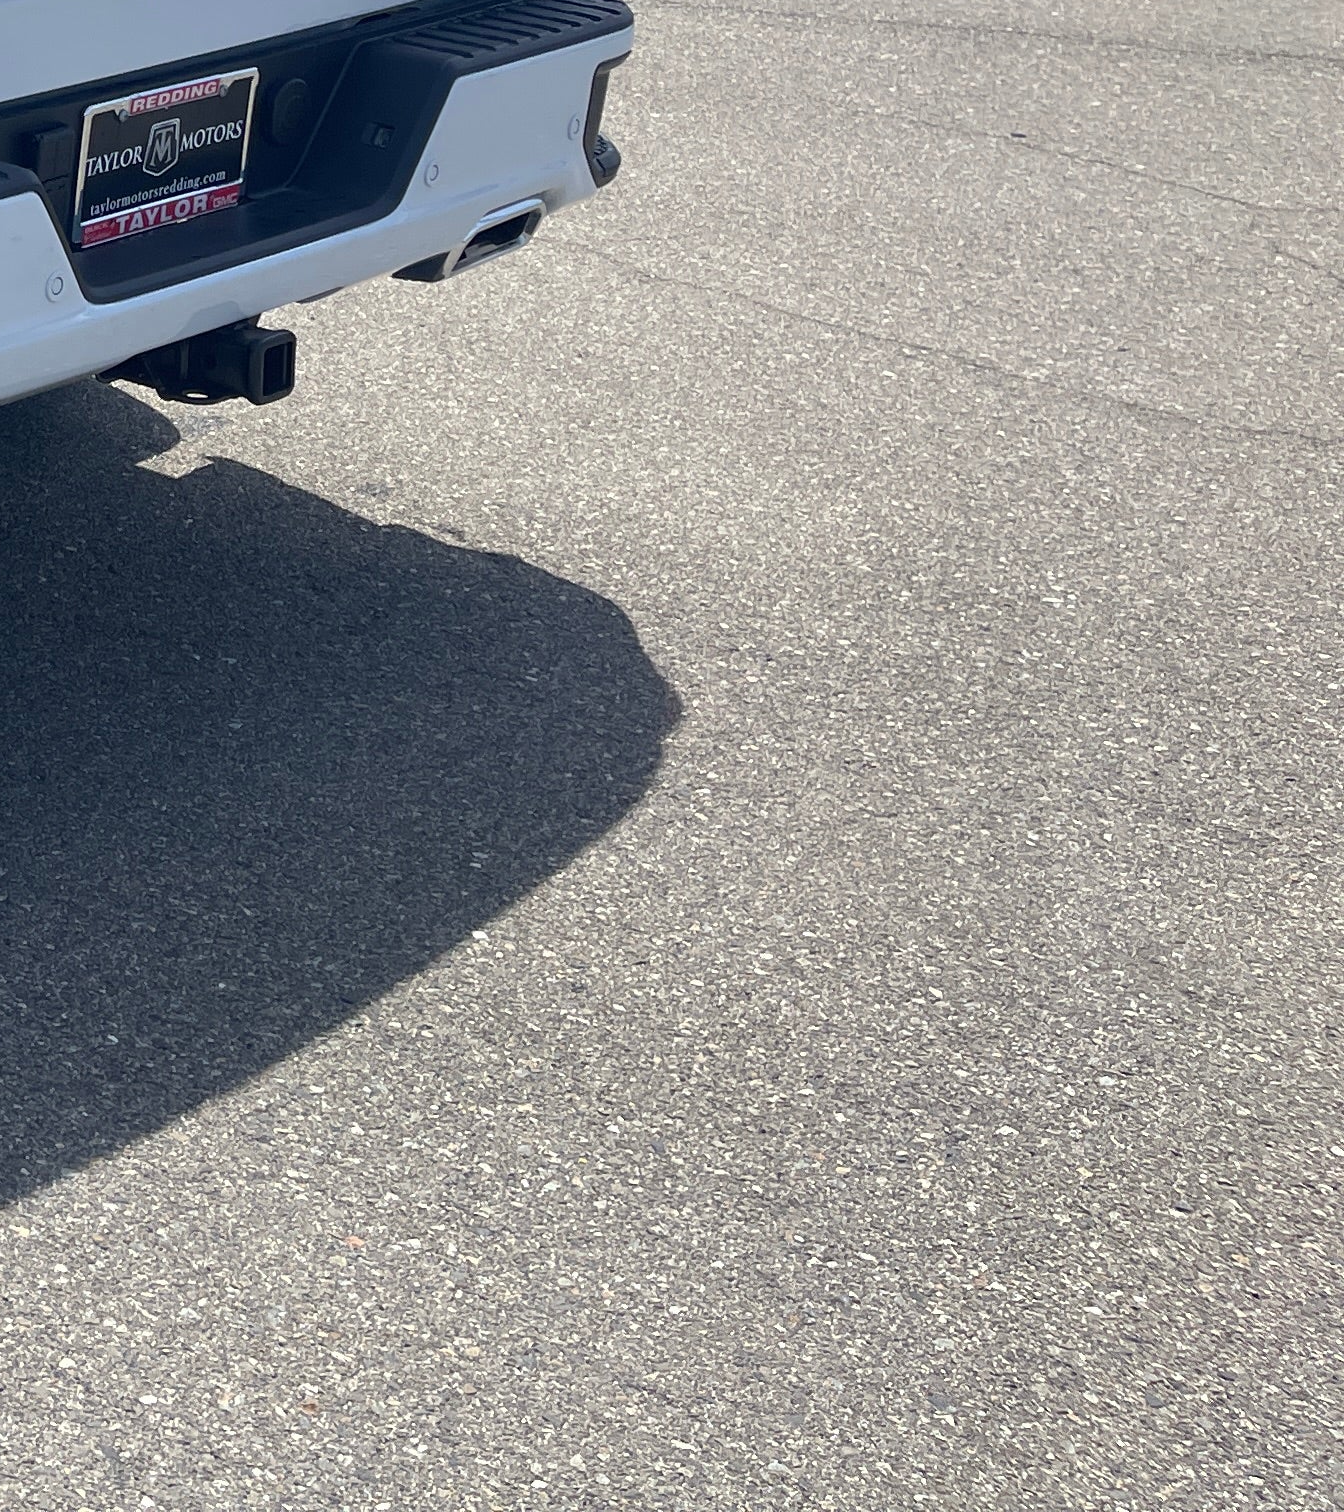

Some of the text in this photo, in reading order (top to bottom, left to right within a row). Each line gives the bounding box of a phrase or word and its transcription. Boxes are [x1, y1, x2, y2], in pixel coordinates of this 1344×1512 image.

[131, 81, 218, 113] REDDING
[86, 145, 143, 177] TAYLOR
[180, 119, 244, 153] MOTORS
[90, 171, 226, 217] taylormotorsredding.com
[115, 195, 210, 234] TAYLOR
[213, 192, 240, 209] GMC
